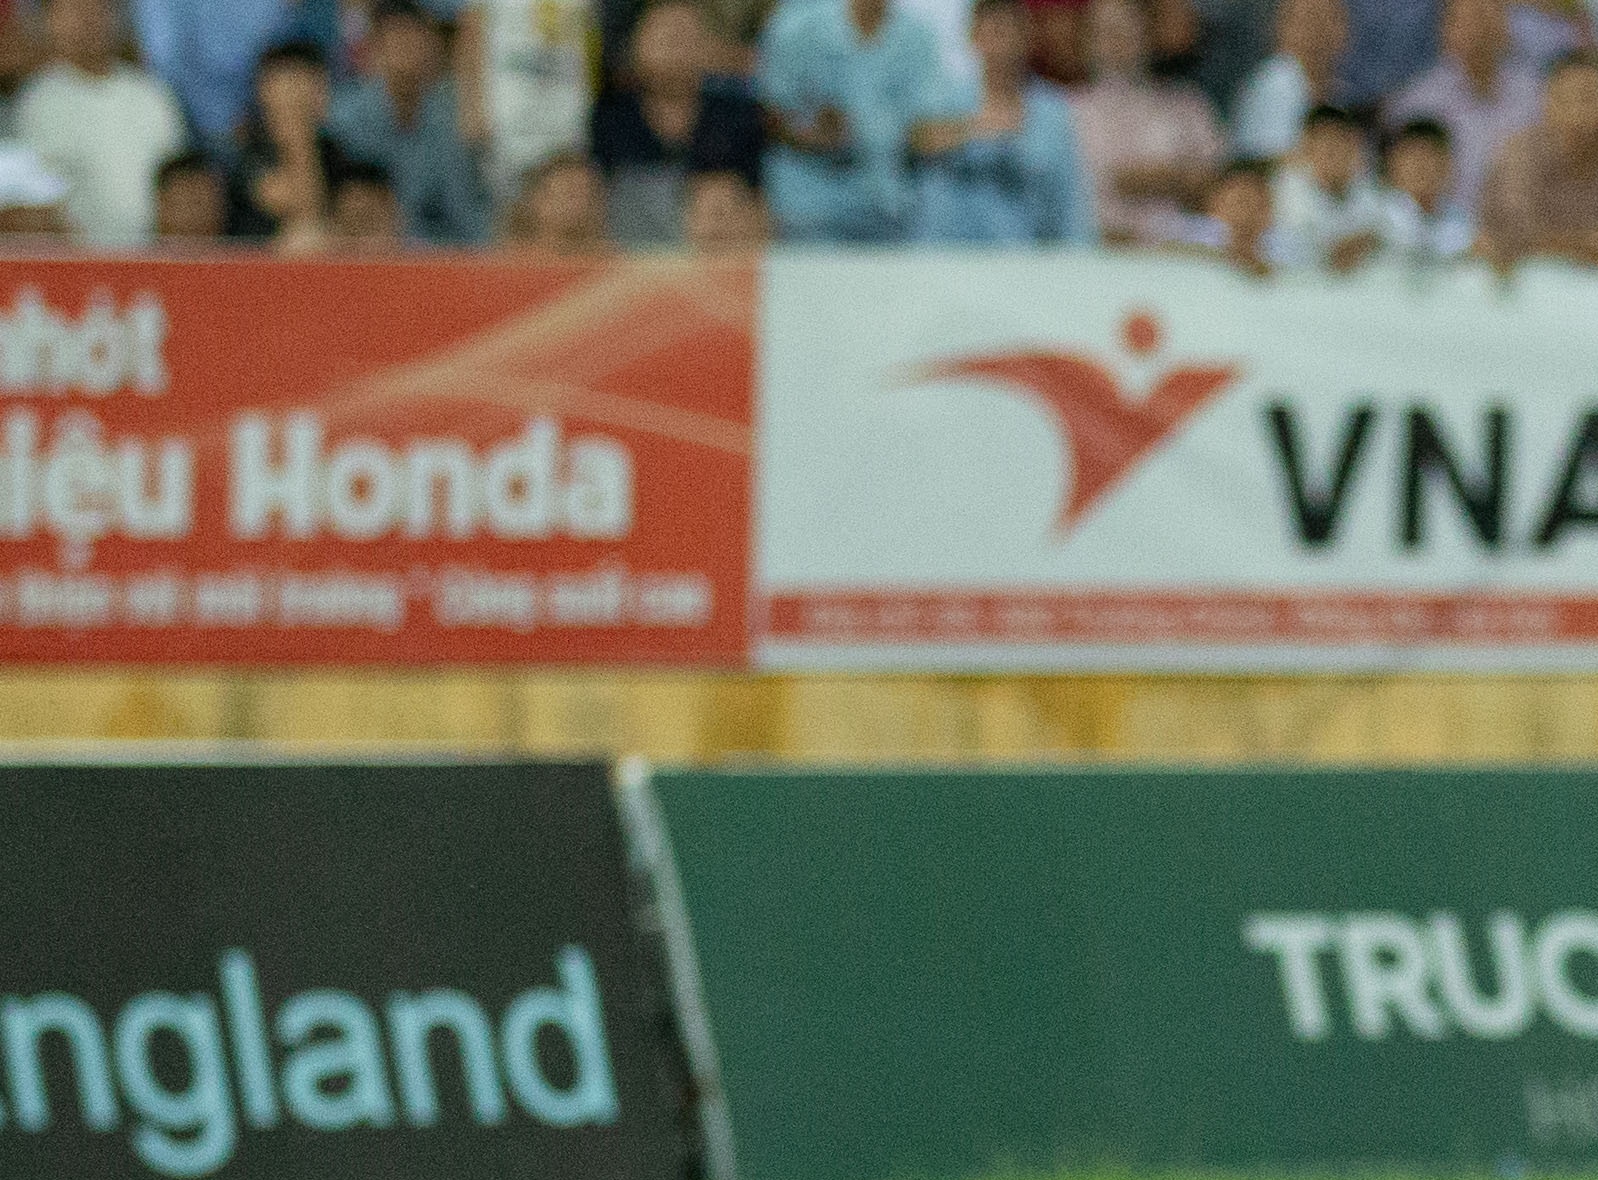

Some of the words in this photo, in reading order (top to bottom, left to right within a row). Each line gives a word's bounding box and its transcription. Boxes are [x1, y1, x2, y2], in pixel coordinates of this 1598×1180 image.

[0, 406, 192, 570] iệu
[228, 406, 636, 542] Honda
[0, 945, 620, 1178] ngland
